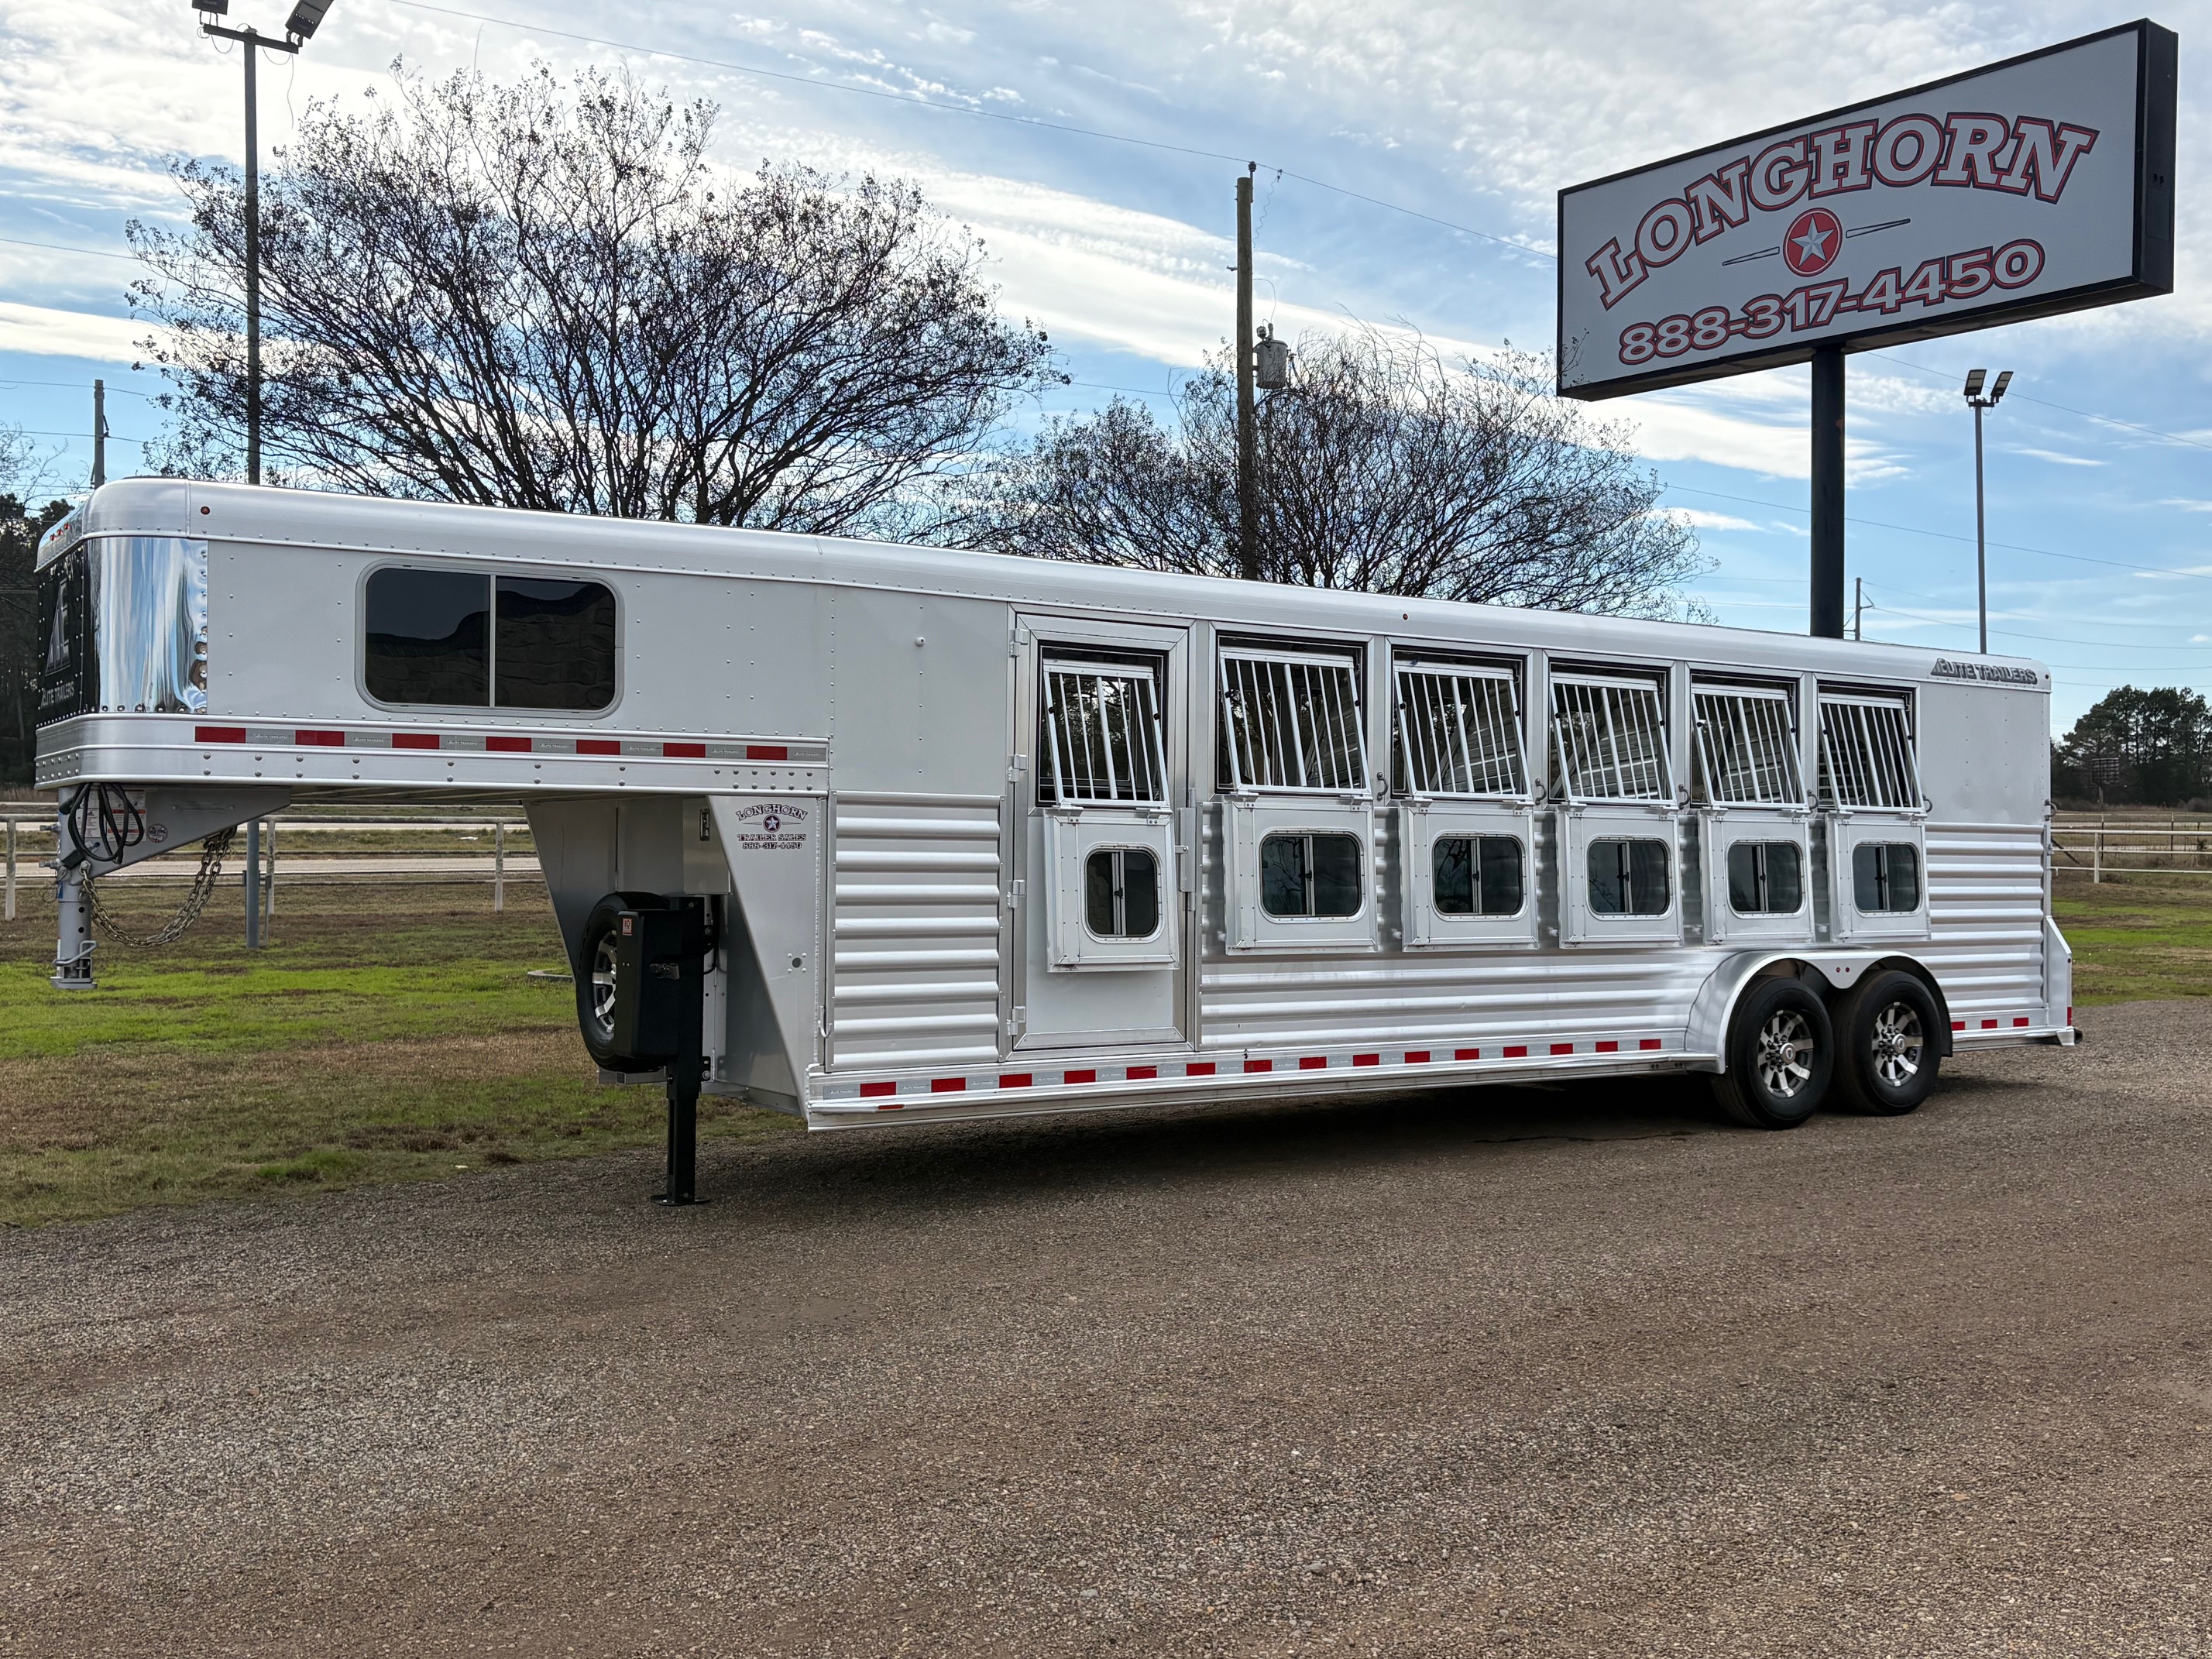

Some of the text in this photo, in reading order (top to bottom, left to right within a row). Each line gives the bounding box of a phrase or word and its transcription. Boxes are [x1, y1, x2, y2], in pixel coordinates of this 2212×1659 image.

[1585, 112, 2100, 310] LONGHORN
[1620, 239, 2045, 365] 888-317-4450
[1930, 658, 2039, 685] ELITE TRAILERS
[736, 804, 808, 821] LONGHORN
